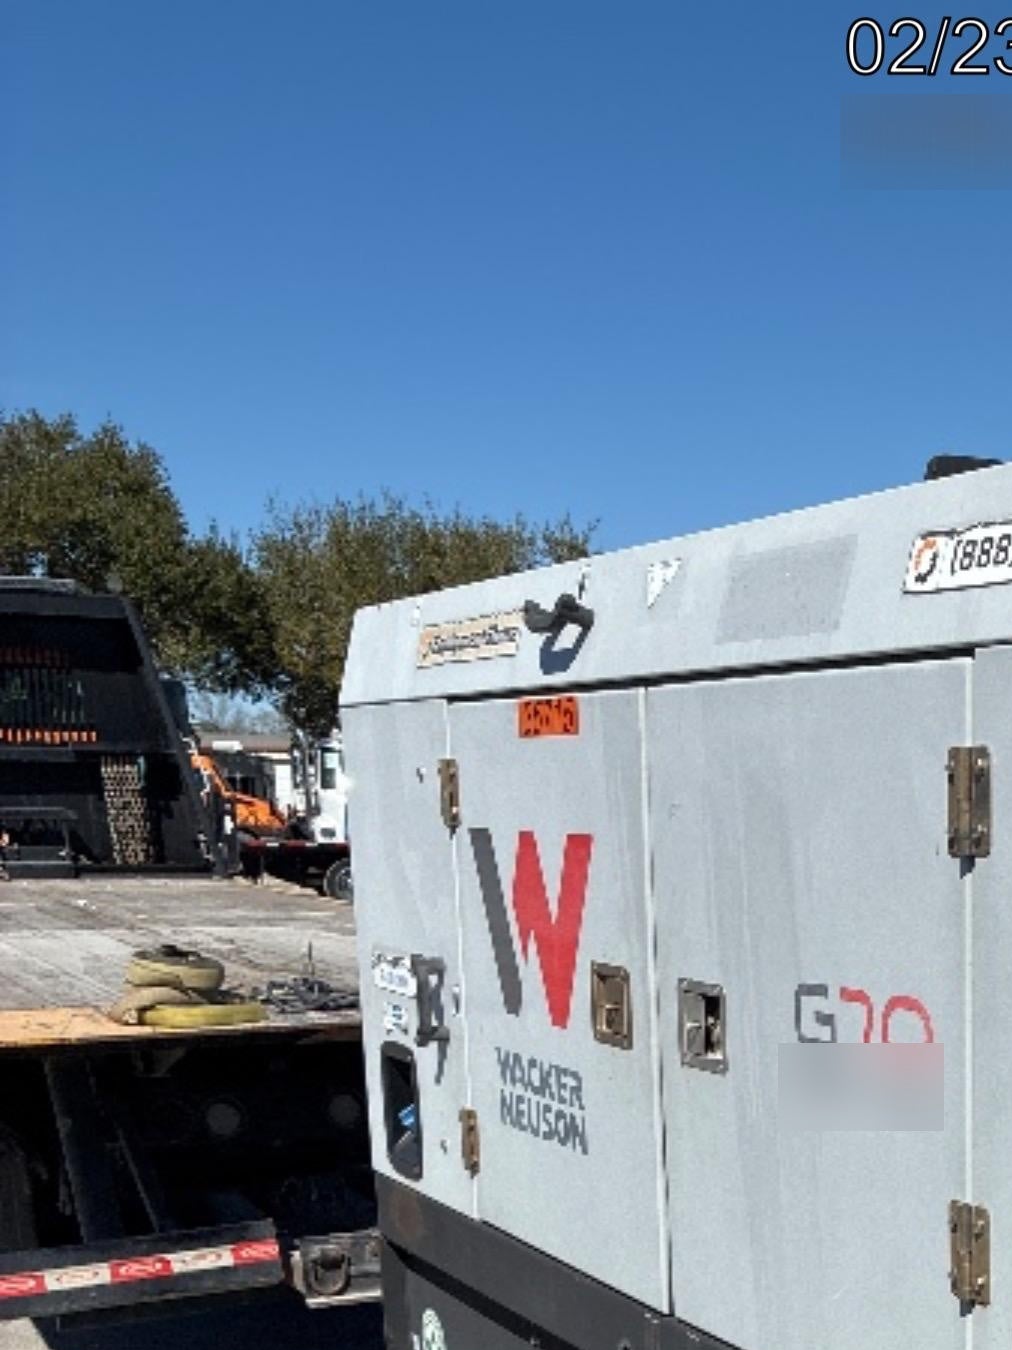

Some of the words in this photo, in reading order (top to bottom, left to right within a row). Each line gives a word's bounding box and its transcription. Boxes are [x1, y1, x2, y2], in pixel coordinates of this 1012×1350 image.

[795, 983, 935, 1044] G70
[494, 1046, 586, 1111] WACKER
[500, 1087, 589, 1156] NEUSON
